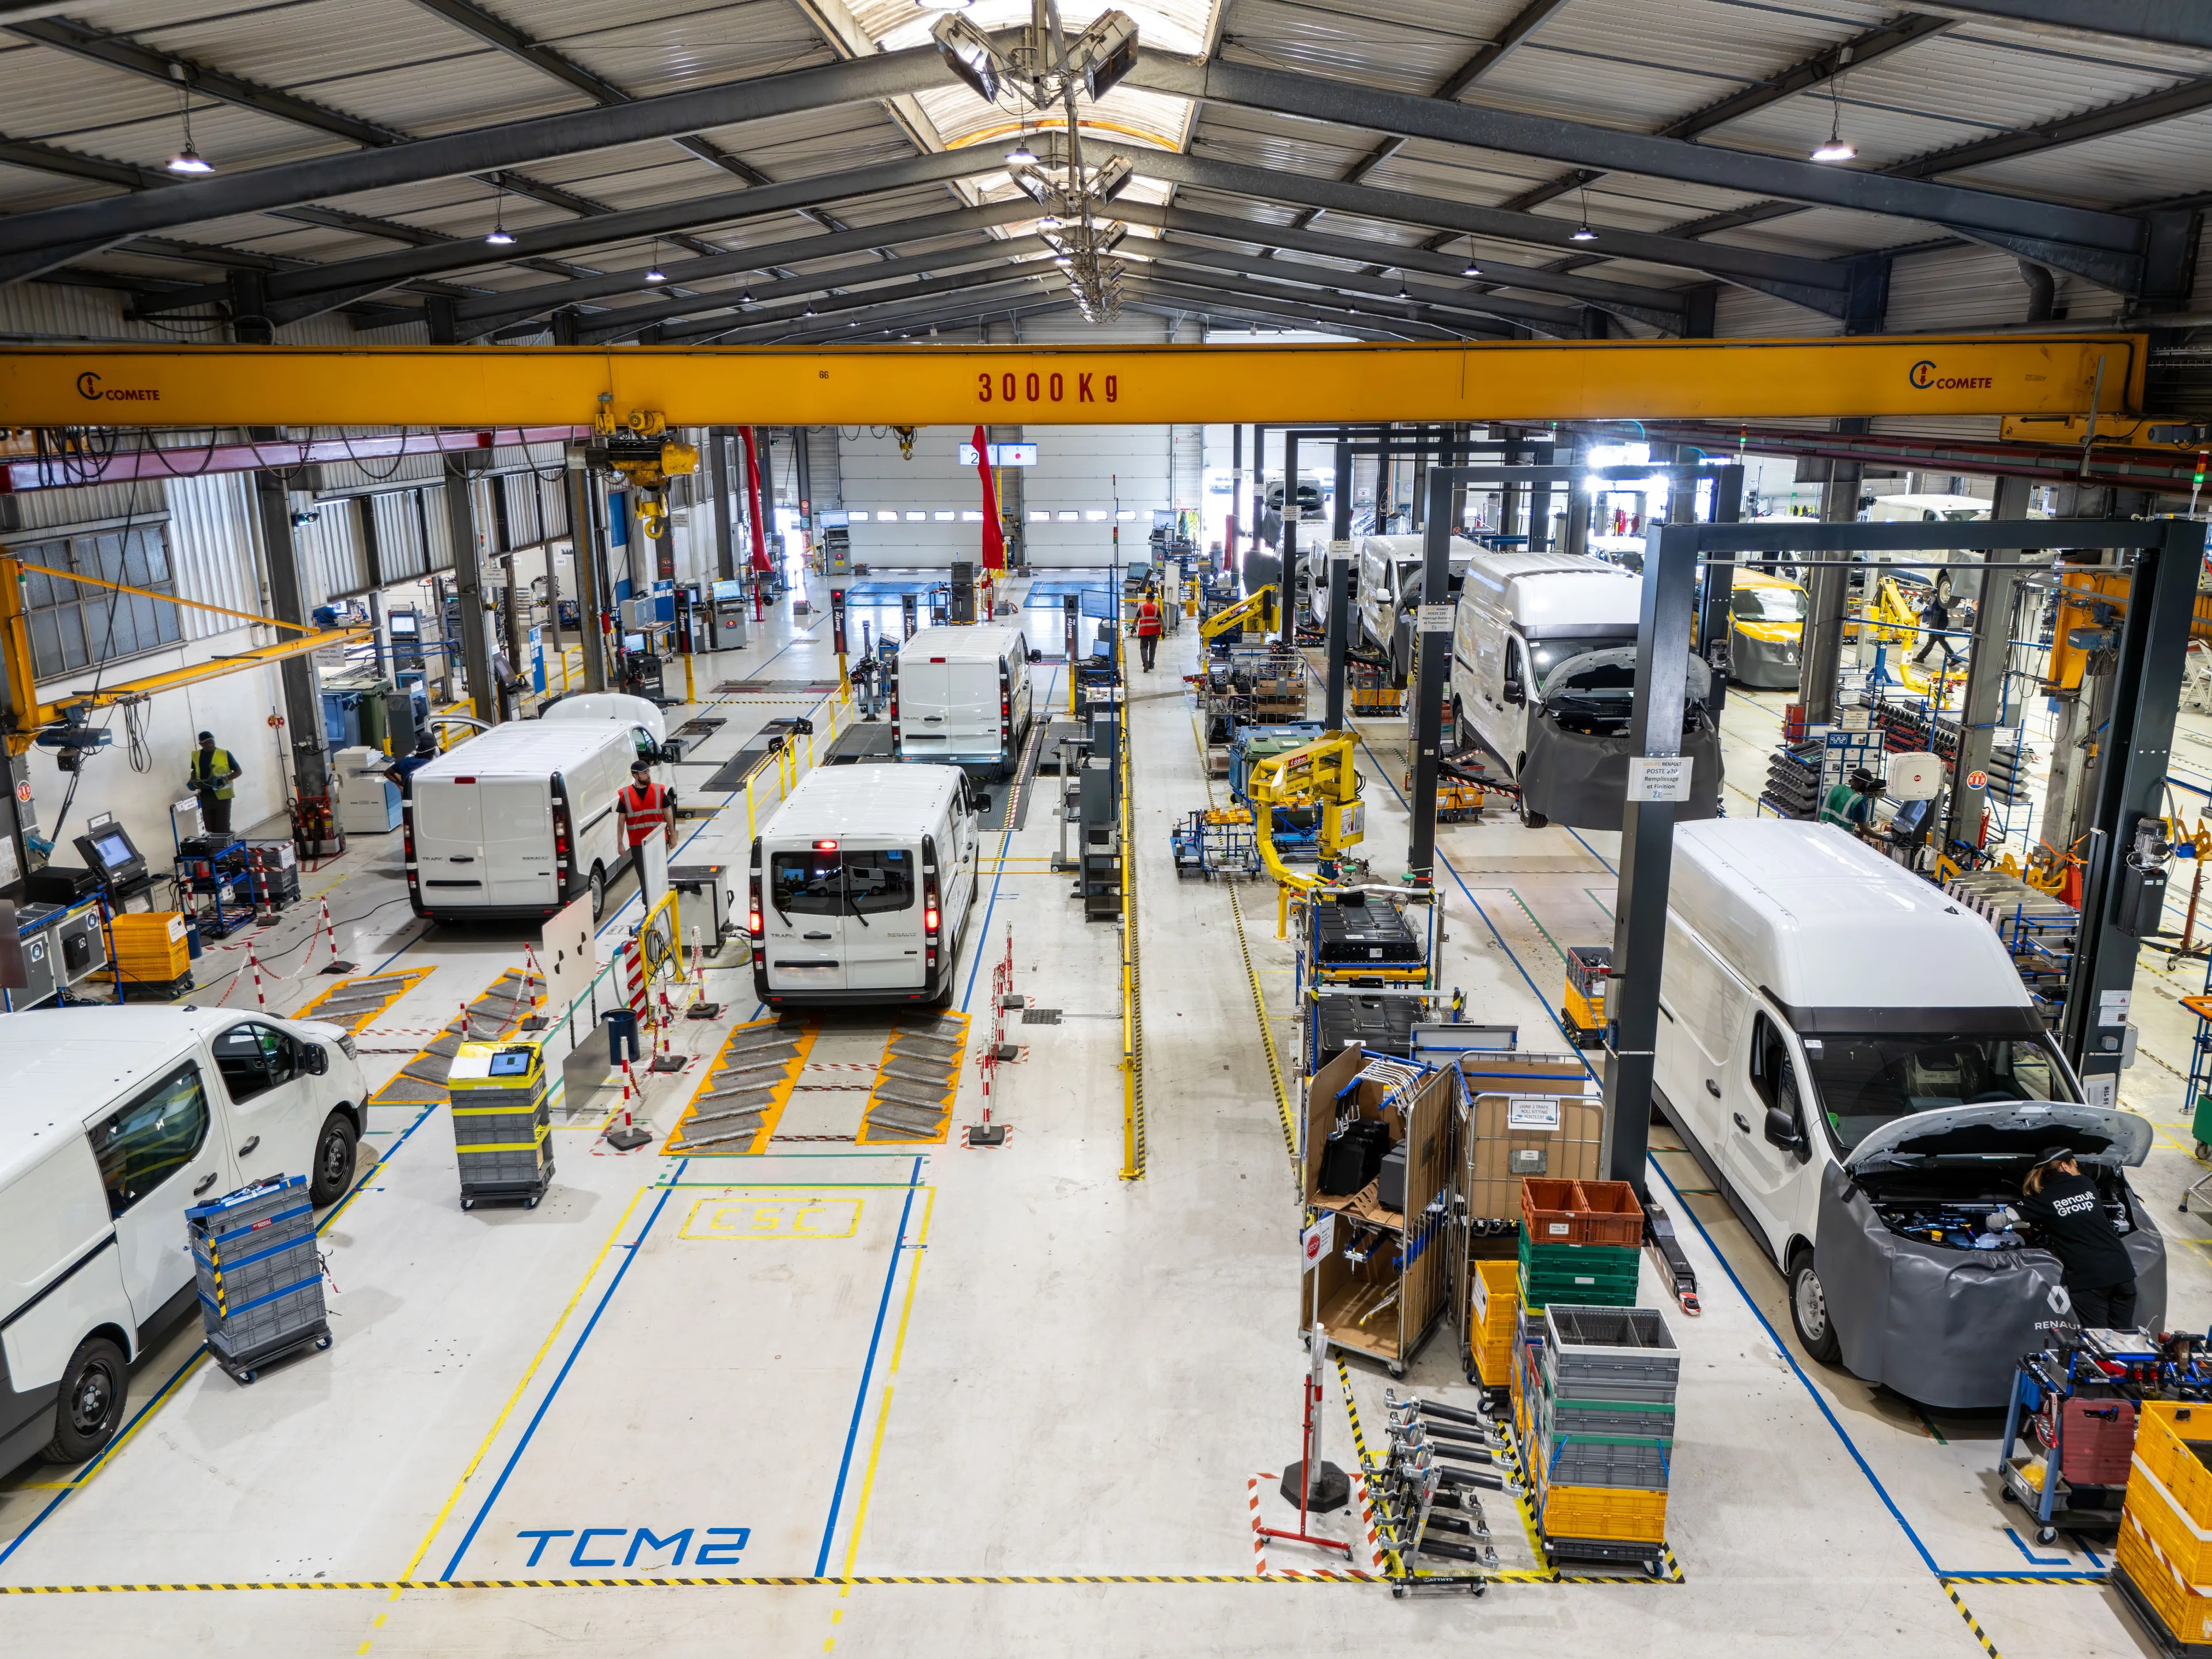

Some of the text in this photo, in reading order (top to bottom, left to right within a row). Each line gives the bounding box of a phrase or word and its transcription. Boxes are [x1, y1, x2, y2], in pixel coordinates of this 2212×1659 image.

[979, 373, 1117, 403] 3000 Kg
[1937, 377, 1992, 389] COMETE
[105, 389, 160, 401] COMETE
[1294, 756, 1307, 765] dalmec
[2052, 1191, 2096, 1210] Renault
[2057, 1201, 2093, 1217] Group
[709, 1207, 827, 1232] CSC
[1308, 1241, 1319, 1253] STOP
[516, 1527, 751, 1567] TCM2
